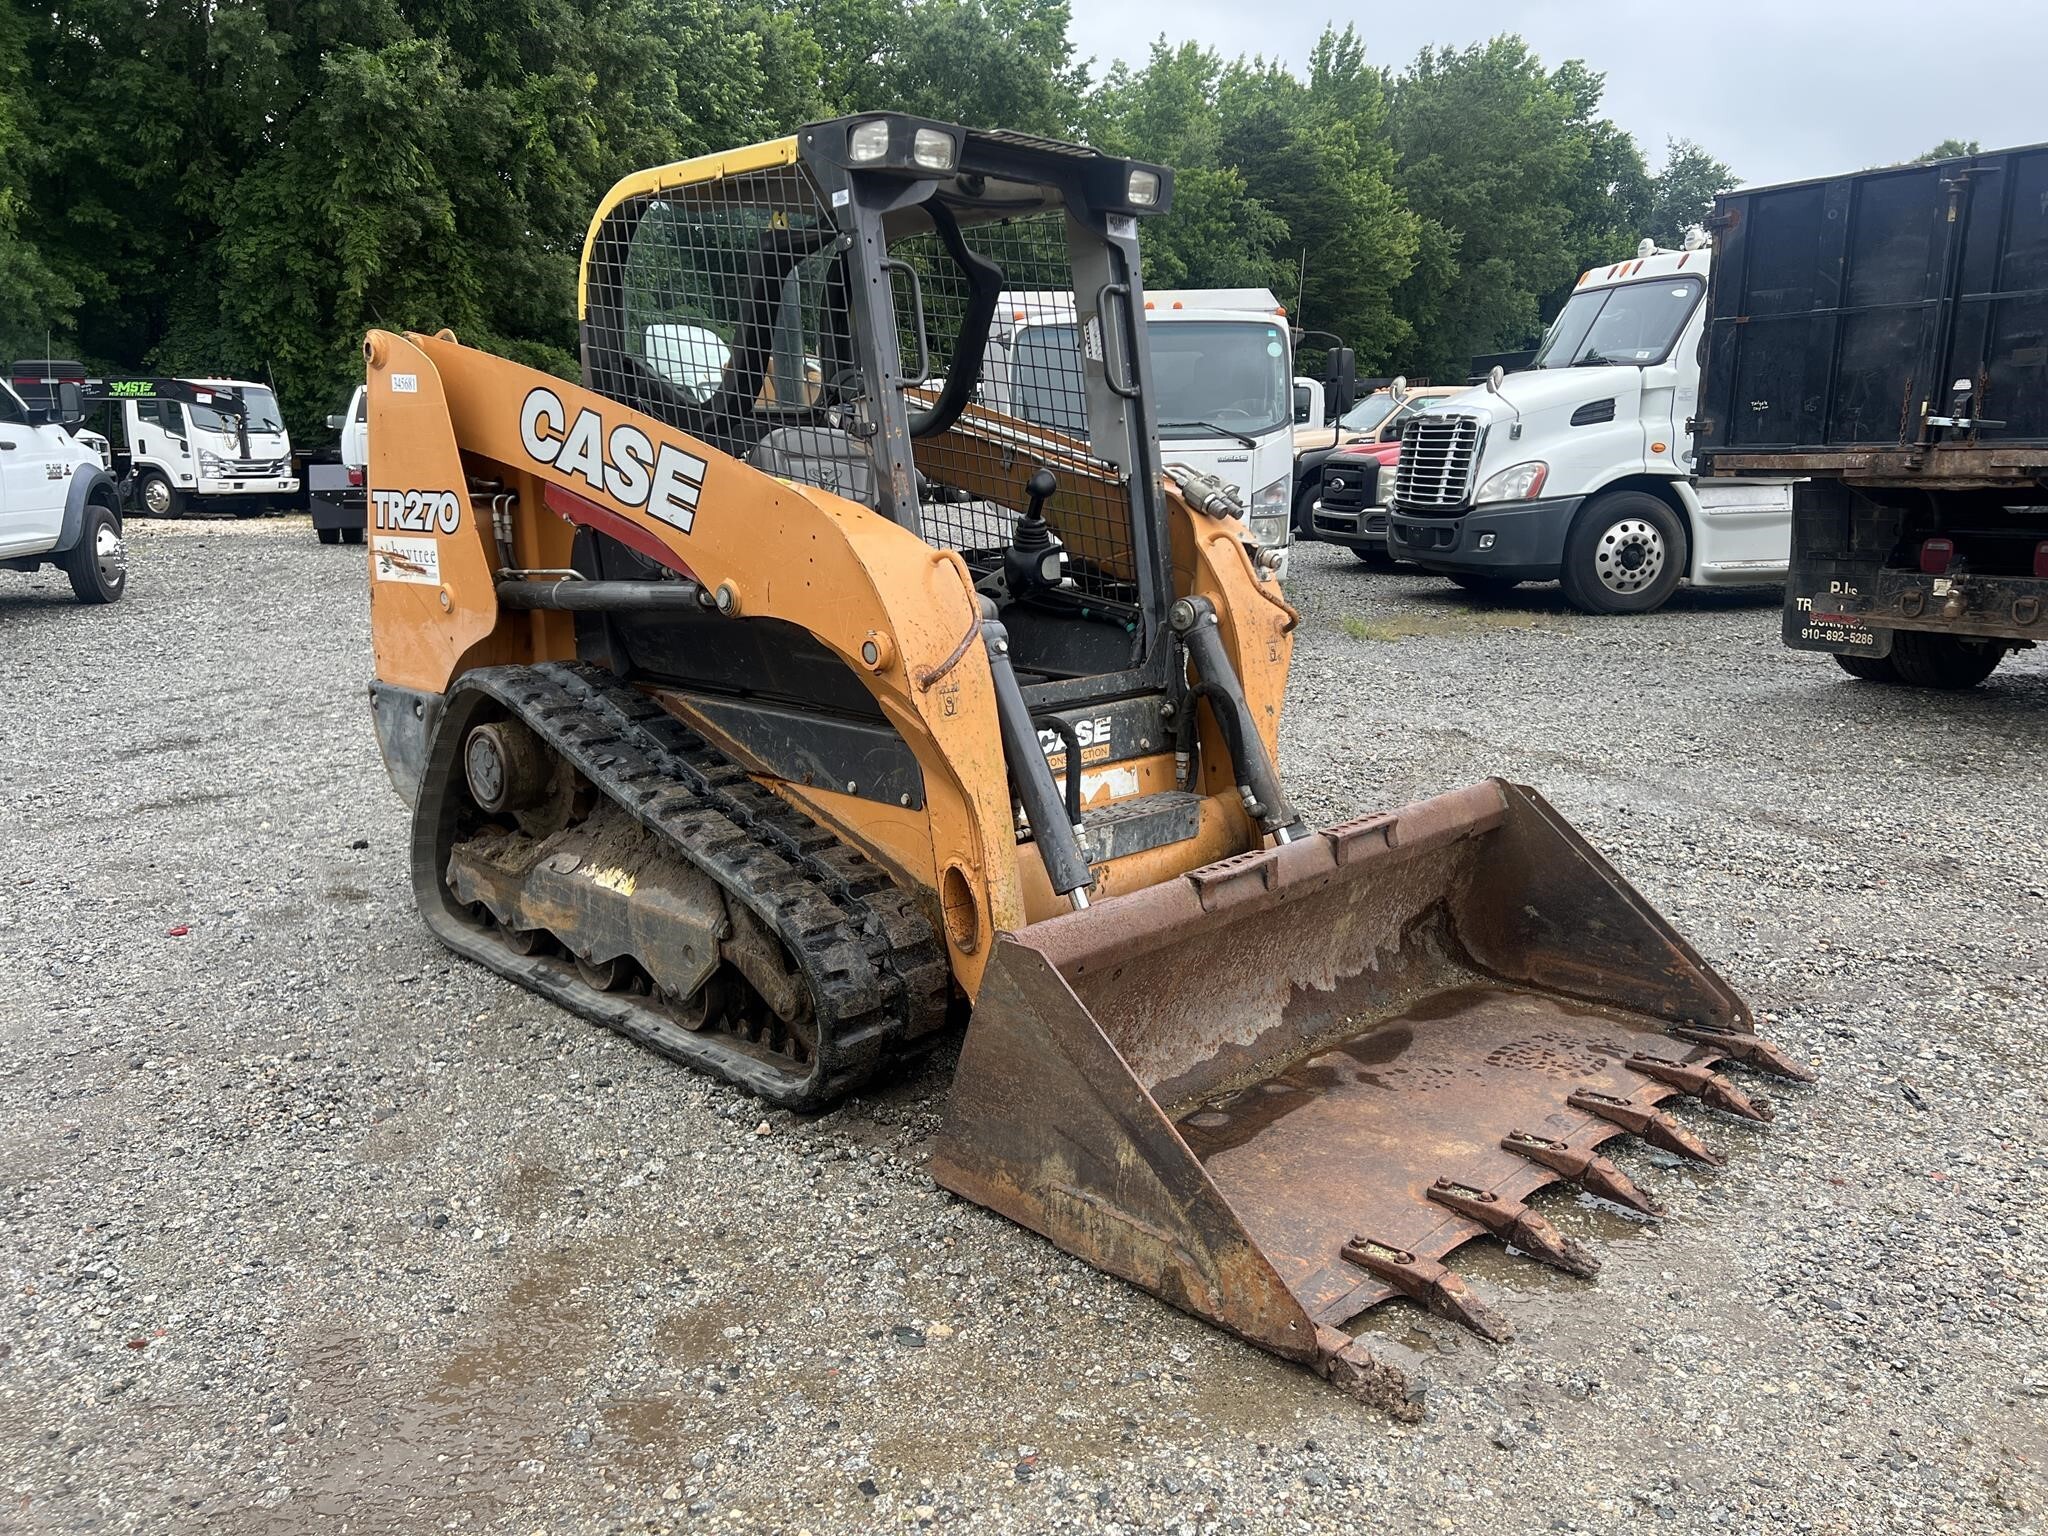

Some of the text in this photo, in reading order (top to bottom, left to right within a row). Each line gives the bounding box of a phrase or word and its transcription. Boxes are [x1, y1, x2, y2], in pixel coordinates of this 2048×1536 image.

[117, 381, 147, 393] MST
[393, 376, 416, 391] 345681
[520, 386, 709, 536] CASE
[371, 489, 461, 534] TR270
[1801, 628, 1874, 645] 910-892-5286
